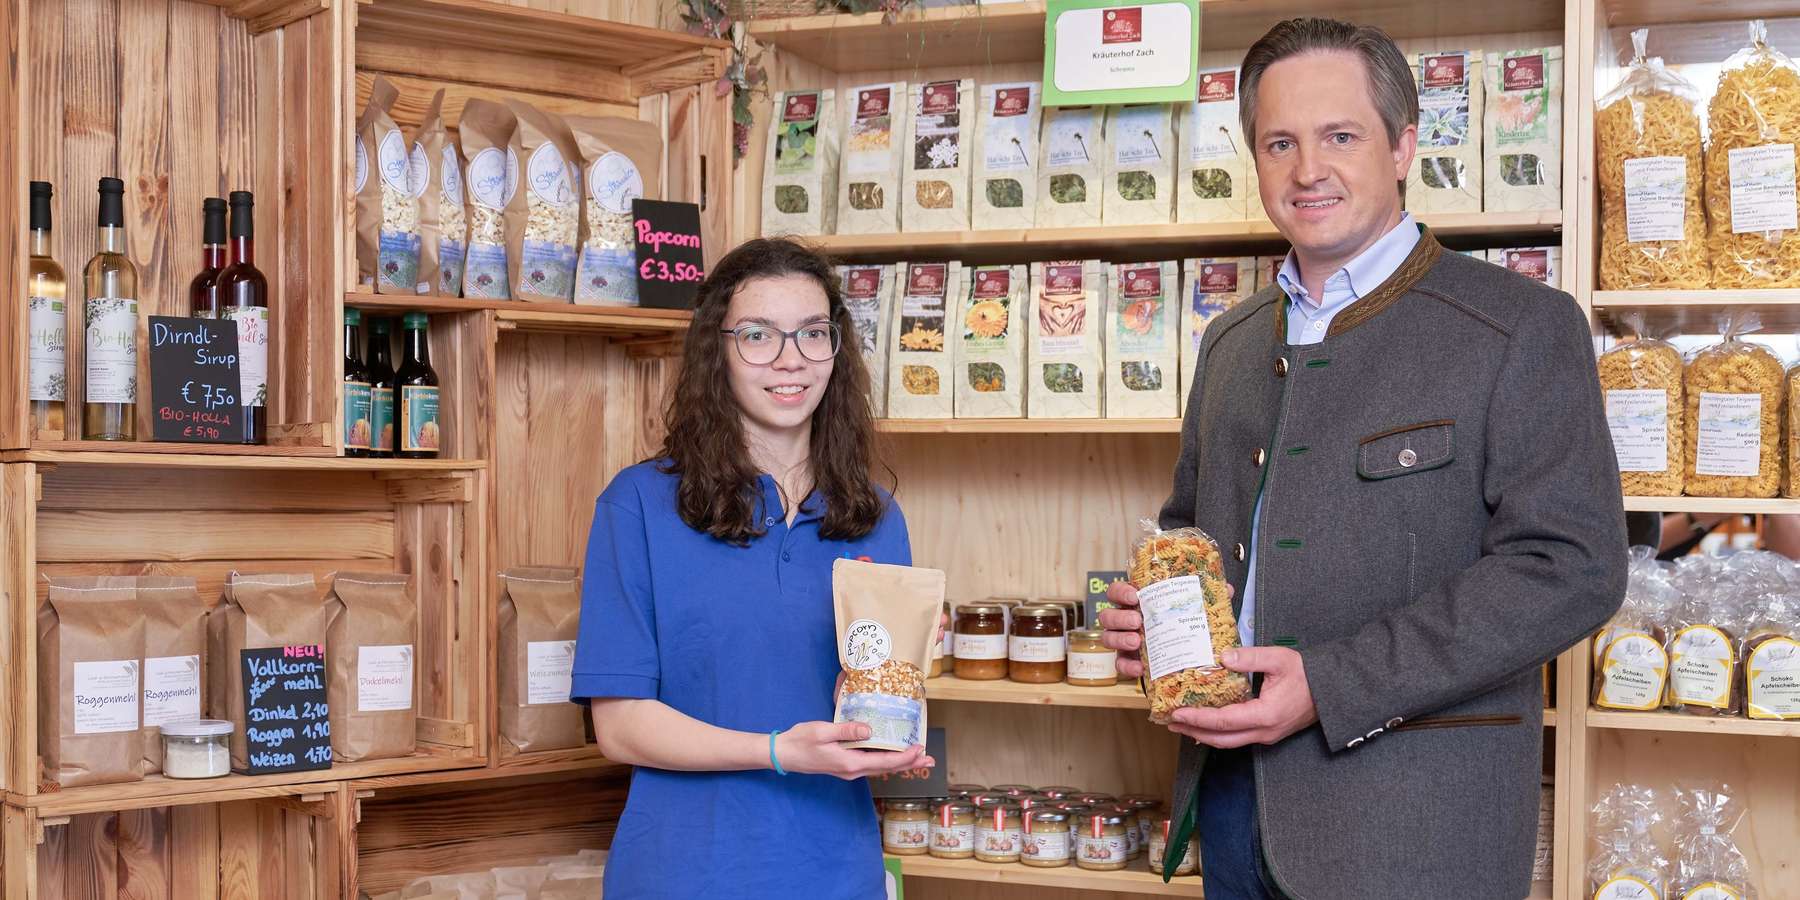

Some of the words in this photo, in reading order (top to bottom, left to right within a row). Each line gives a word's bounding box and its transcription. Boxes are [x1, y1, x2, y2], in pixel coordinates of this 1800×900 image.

[1092, 49, 1134, 59] Kräuterhof
[1136, 48, 1154, 57] Zach
[635, 218, 701, 254] Popcorn
[154, 323, 217, 346] Dirndl-
[194, 348, 236, 368] Sirup
[181, 381, 197, 404] €
[201, 384, 235, 410] 7,50
[160, 407, 230, 426] BIO-HOLLA
[196, 426, 219, 439] 5,90
[1178, 616, 1203, 625] Spiralen
[284, 645, 324, 659] NEU!
[248, 658, 324, 677] Vollkorn-
[1622, 668, 1644, 677] Schoko
[1676, 666, 1718, 677] Apfelscheiben
[1686, 661, 1709, 669] Schoko
[1612, 673, 1652, 685] Apfelscheiben
[76, 693, 136, 708] Roggenmehl
[144, 687, 198, 702] Roggenmehl
[249, 704, 298, 721] Dinkel
[302, 702, 329, 719] 2,10
[247, 727, 295, 747] Roggen
[302, 721, 330, 739] 1,90
[250, 752, 296, 767] Weizen
[305, 746, 332, 763] 1,70
